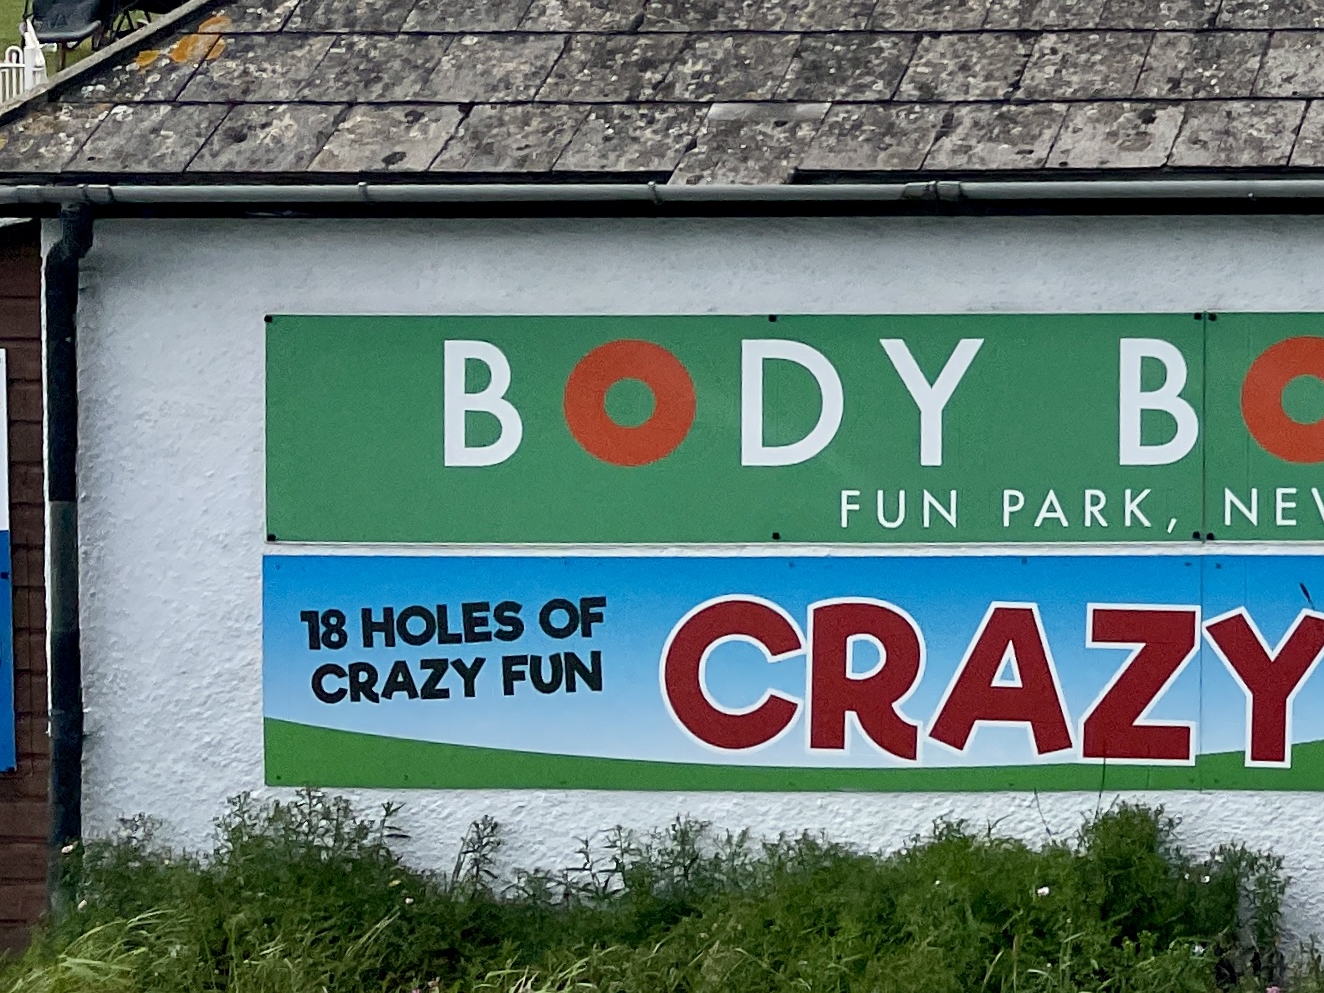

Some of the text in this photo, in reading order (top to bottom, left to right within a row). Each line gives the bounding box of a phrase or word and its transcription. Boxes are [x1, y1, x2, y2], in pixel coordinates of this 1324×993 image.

[443, 338, 985, 467] BODY
[840, 488, 957, 528] FUN
[1002, 488, 1178, 534] PARK,
[300, 596, 607, 651] 18 HOLES OF
[310, 650, 603, 704] CRAZY FUN
